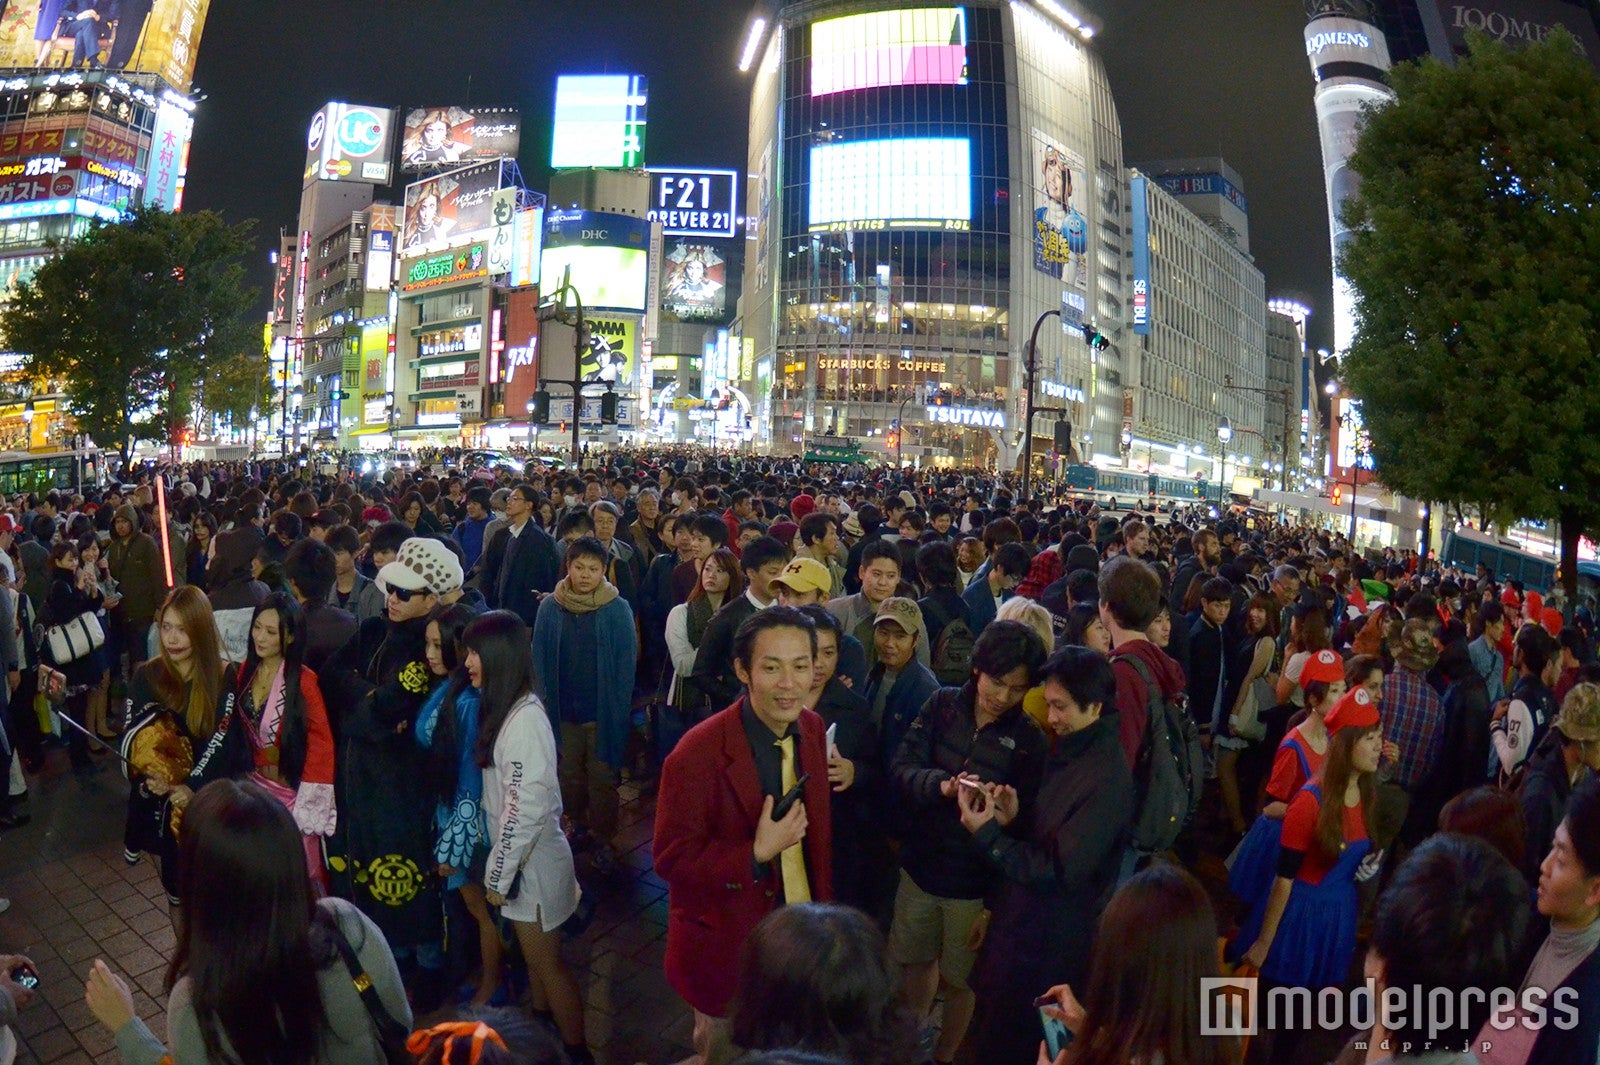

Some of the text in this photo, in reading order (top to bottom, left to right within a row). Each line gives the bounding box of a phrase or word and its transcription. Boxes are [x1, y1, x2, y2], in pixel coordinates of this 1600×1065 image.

[340, 119, 382, 146] UC
[85, 132, 136, 160] コンタクト
[25, 157, 67, 176] ガスト
[117, 169, 143, 189] ガスト
[1165, 178, 1212, 193] SEIBU
[0, 181, 46, 203] ガスト
[660, 177, 711, 208] F21
[647, 211, 708, 228] OREVER
[712, 212, 729, 229] 21
[581, 229, 608, 240] DHC
[1134, 280, 1146, 324] SEIBU
[819, 358, 946, 373] STARBUCKS COFFEE
[1041, 379, 1085, 403] TSUTAYA
[926, 405, 1005, 428] TSUTAYA
